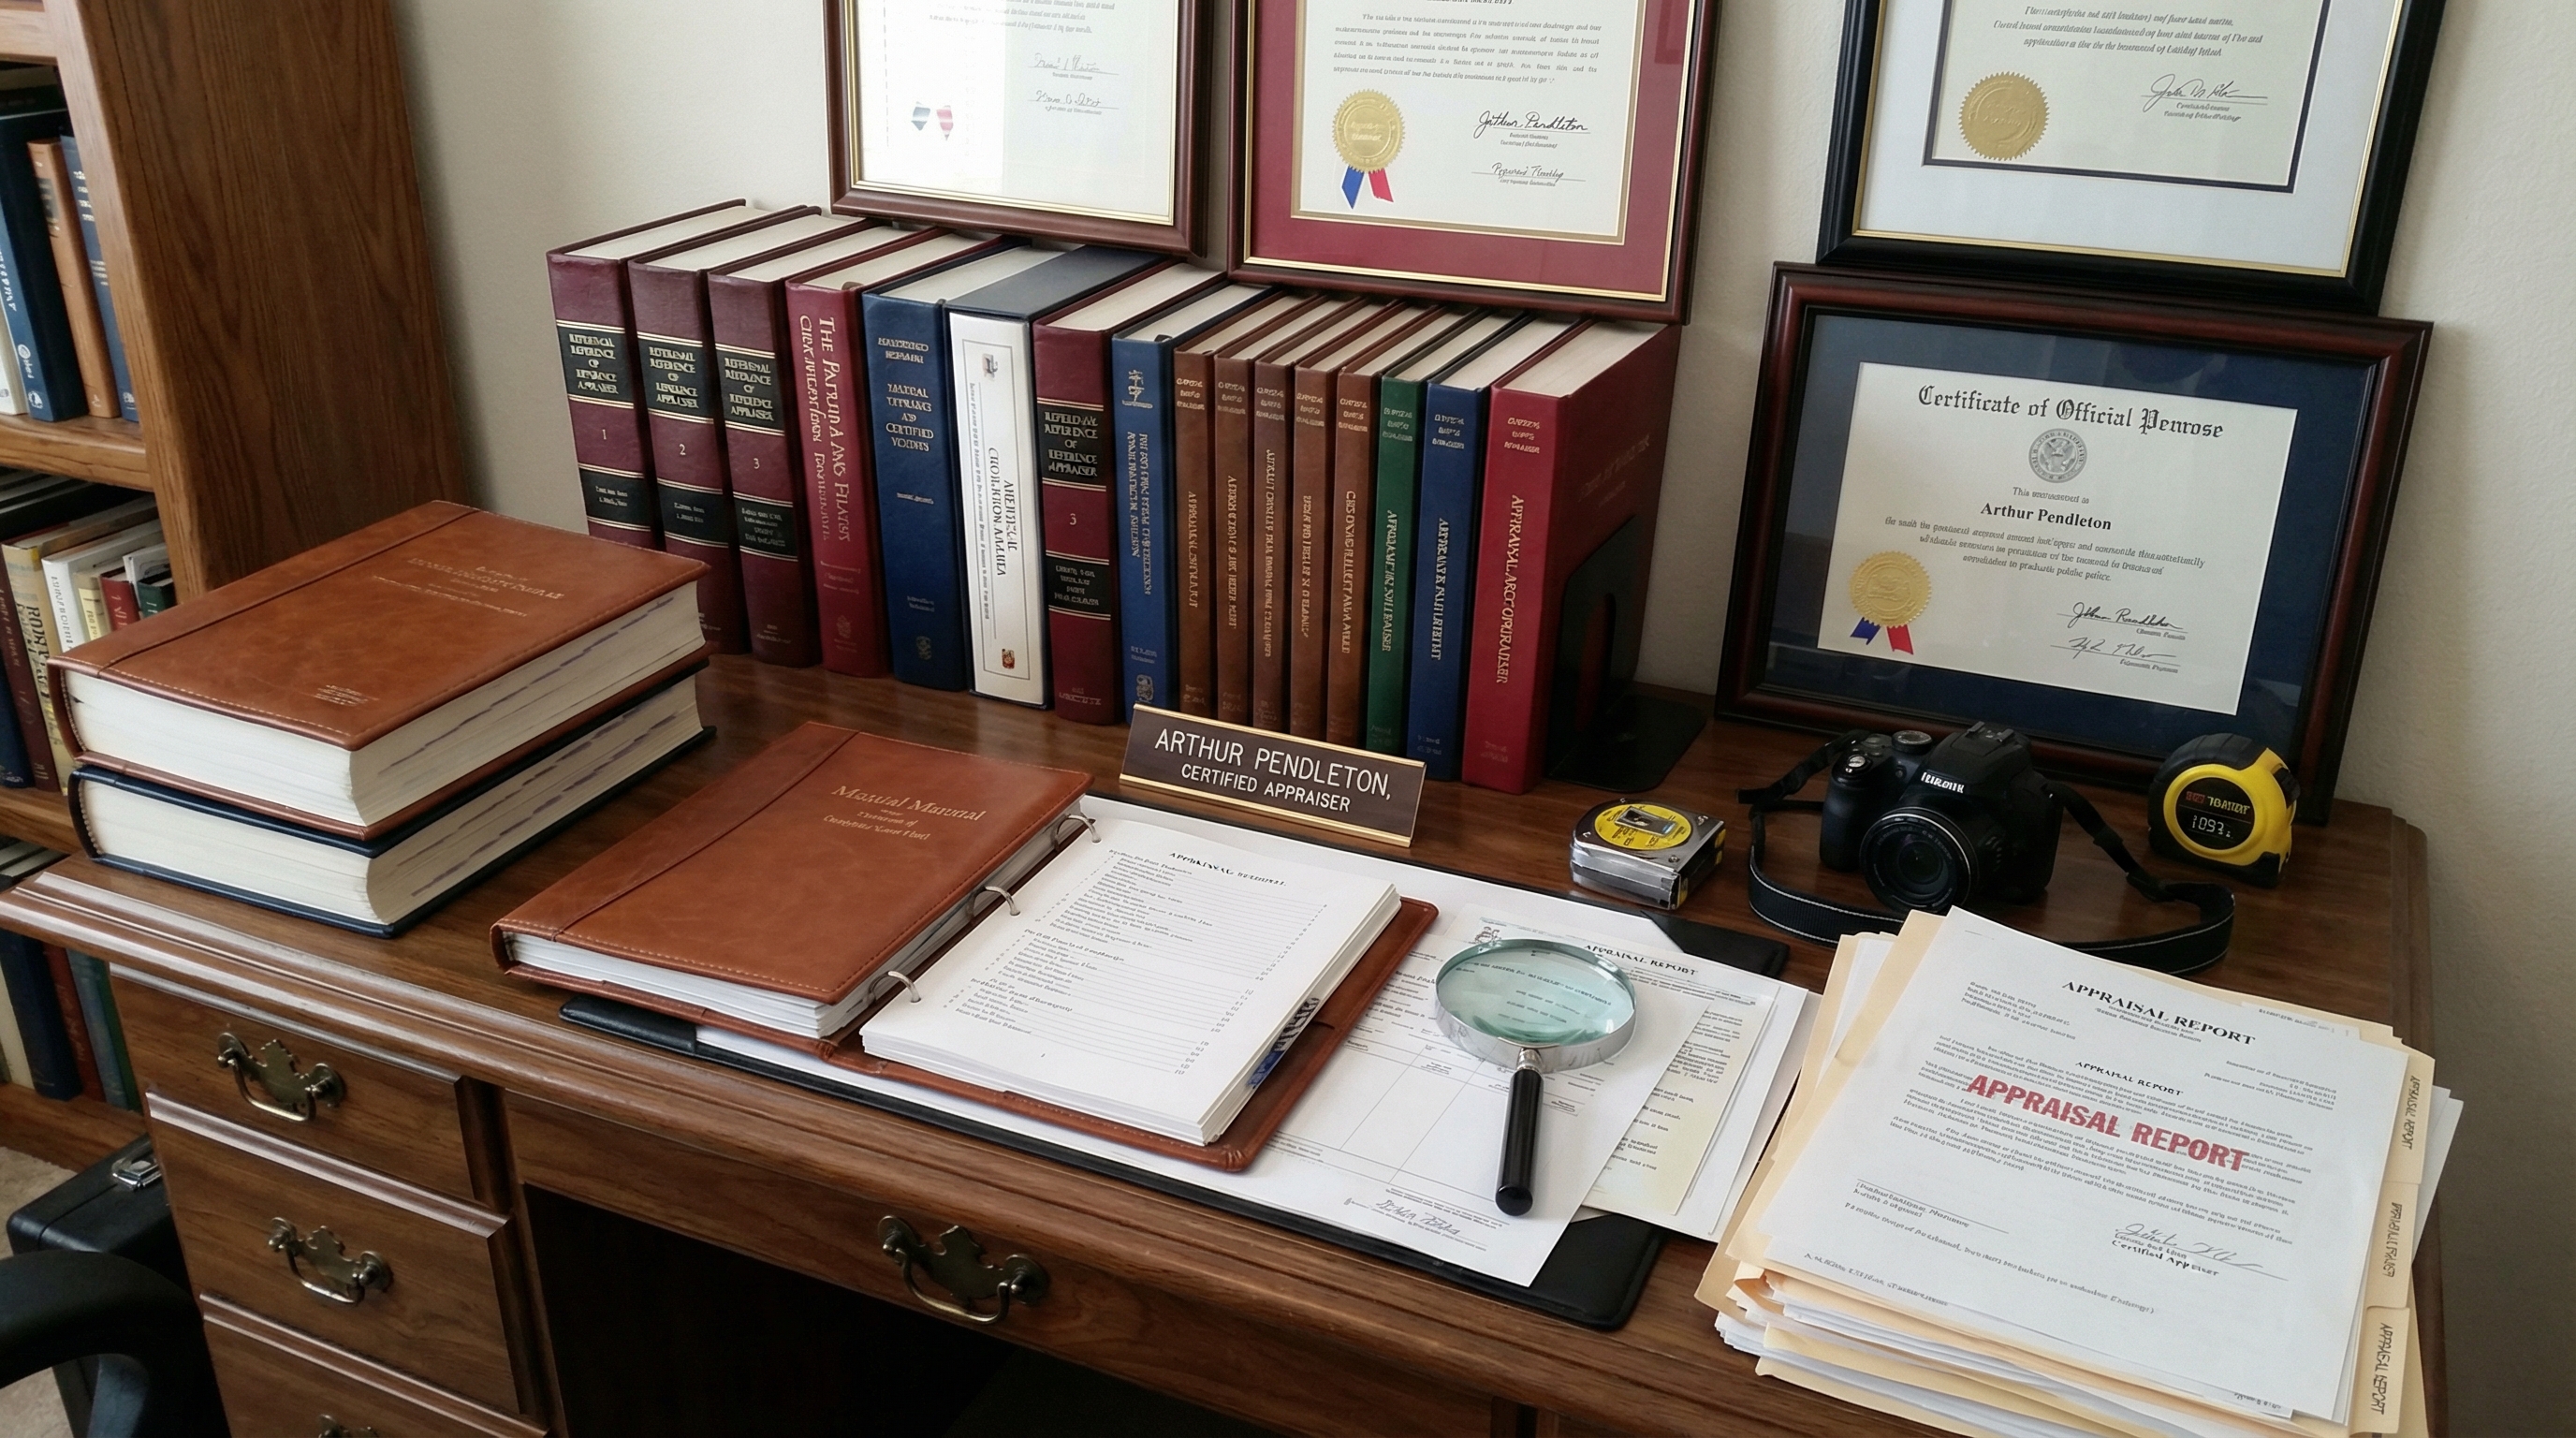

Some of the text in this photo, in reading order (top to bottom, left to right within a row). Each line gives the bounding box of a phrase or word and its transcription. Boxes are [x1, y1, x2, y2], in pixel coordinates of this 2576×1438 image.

[1919, 385, 2020, 415] Certificate
[2027, 398, 2050, 418] of
[2056, 399, 2133, 427] Official
[602, 429, 607, 440] 1
[680, 443, 686, 456] 2
[754, 458, 760, 469] 3
[1069, 513, 1077, 525] 3
[1981, 503, 2112, 530] Arthur Pendleton
[1154, 728, 1391, 800] ARTHUR PENDLETON,
[1181, 763, 1351, 813] CERTIFIED APPRAISER
[2062, 981, 2169, 1021] APPRAISAL
[2174, 1016, 2256, 1045] REPORT
[1967, 1074, 2249, 1172] APPRAISAL REPORT
